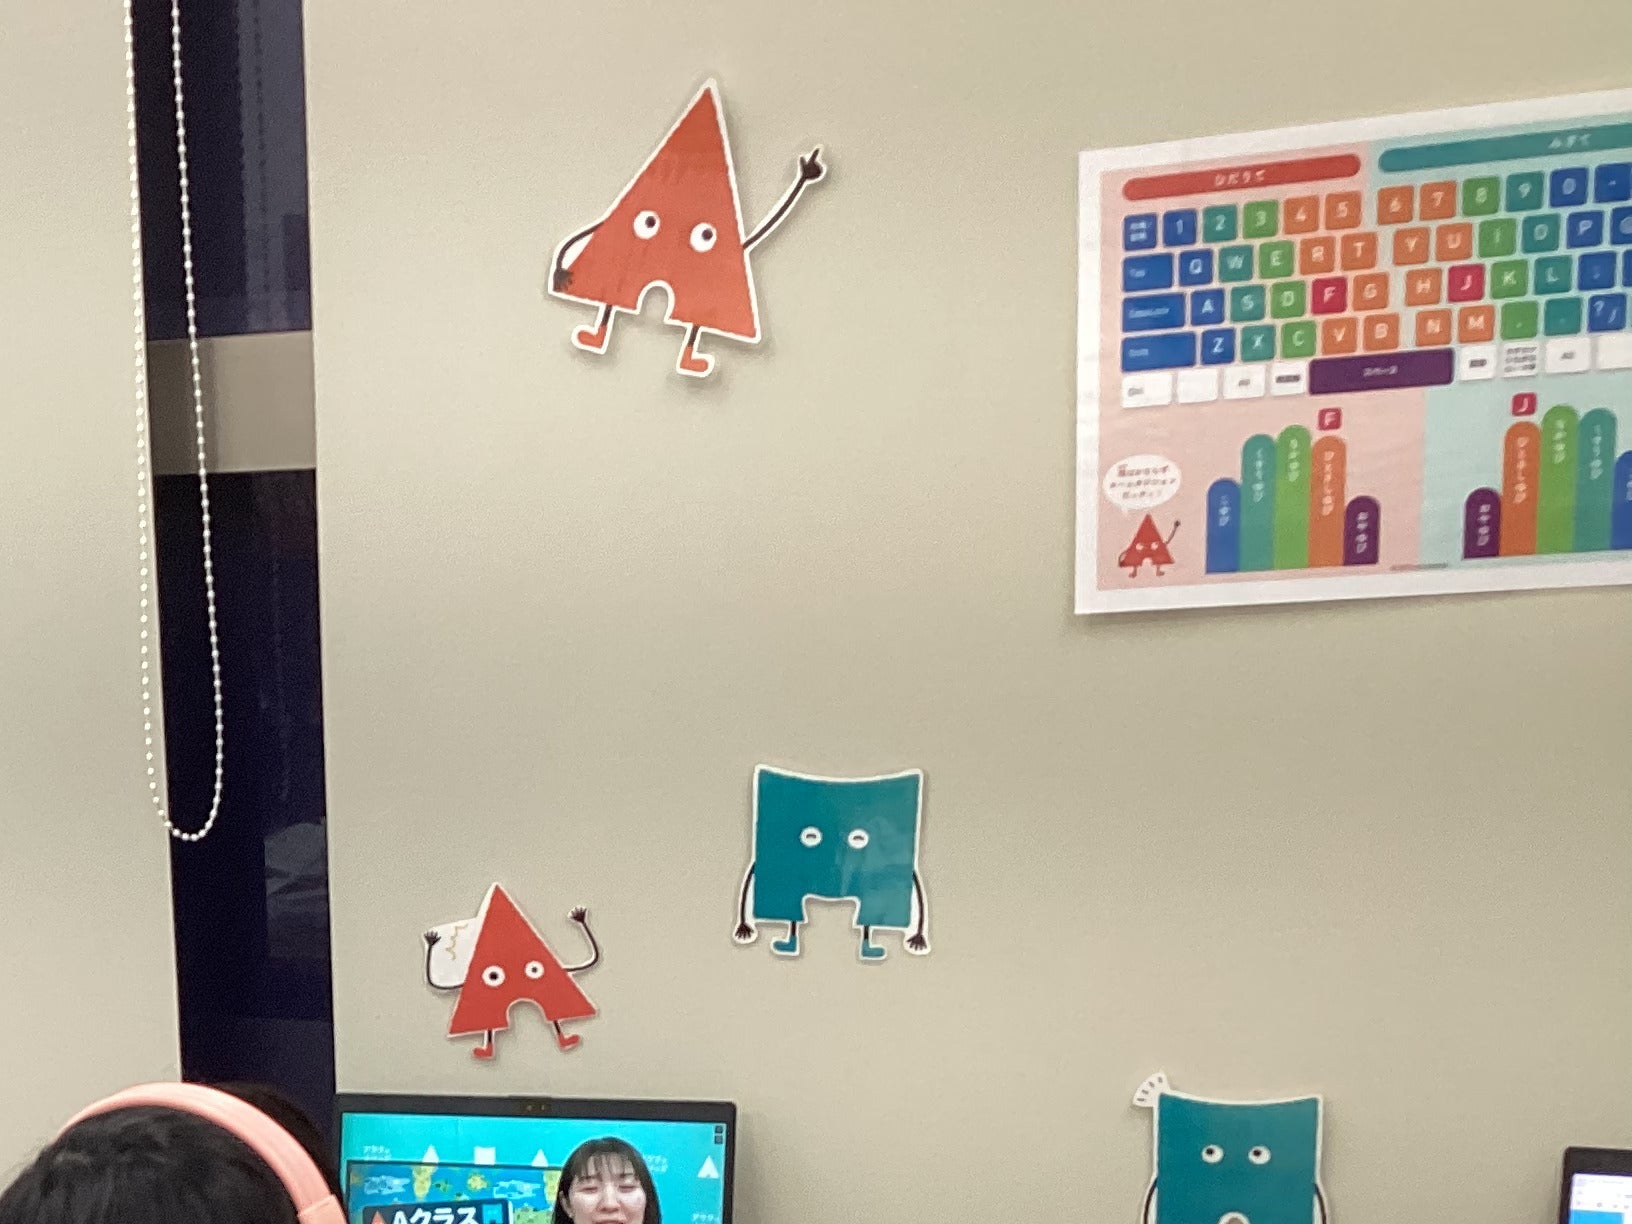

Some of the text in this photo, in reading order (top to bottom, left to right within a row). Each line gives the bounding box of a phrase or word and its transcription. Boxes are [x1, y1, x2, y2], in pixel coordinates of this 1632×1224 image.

[1176, 218, 1184, 236] 1
[1215, 214, 1227, 231] 2
[1256, 210, 1267, 227] 3
[1296, 206, 1307, 222] 4
[1337, 201, 1348, 218] 5
[1390, 197, 1402, 213] 6
[1432, 190, 1445, 207] 7
[1519, 182, 1531, 198] 9
[1189, 257, 1203, 275] Q
[1226, 254, 1245, 270] W
[1271, 250, 1283, 267] E
[1353, 241, 1365, 258] T
[1405, 236, 1418, 252] Y
[1446, 231, 1462, 249] U
[1533, 222, 1549, 241] O
[1578, 218, 1593, 236] P
[1201, 266, 1560, 314] A S D F G H J K L
[1212, 336, 1225, 354] Z
[1252, 333, 1265, 349] X
[1292, 330, 1305, 346] C
[1333, 326, 1346, 342] V
[1426, 317, 1442, 334] N
[1468, 313, 1485, 330] M
[1323, 411, 1336, 427] F
[1518, 396, 1530, 413] J
